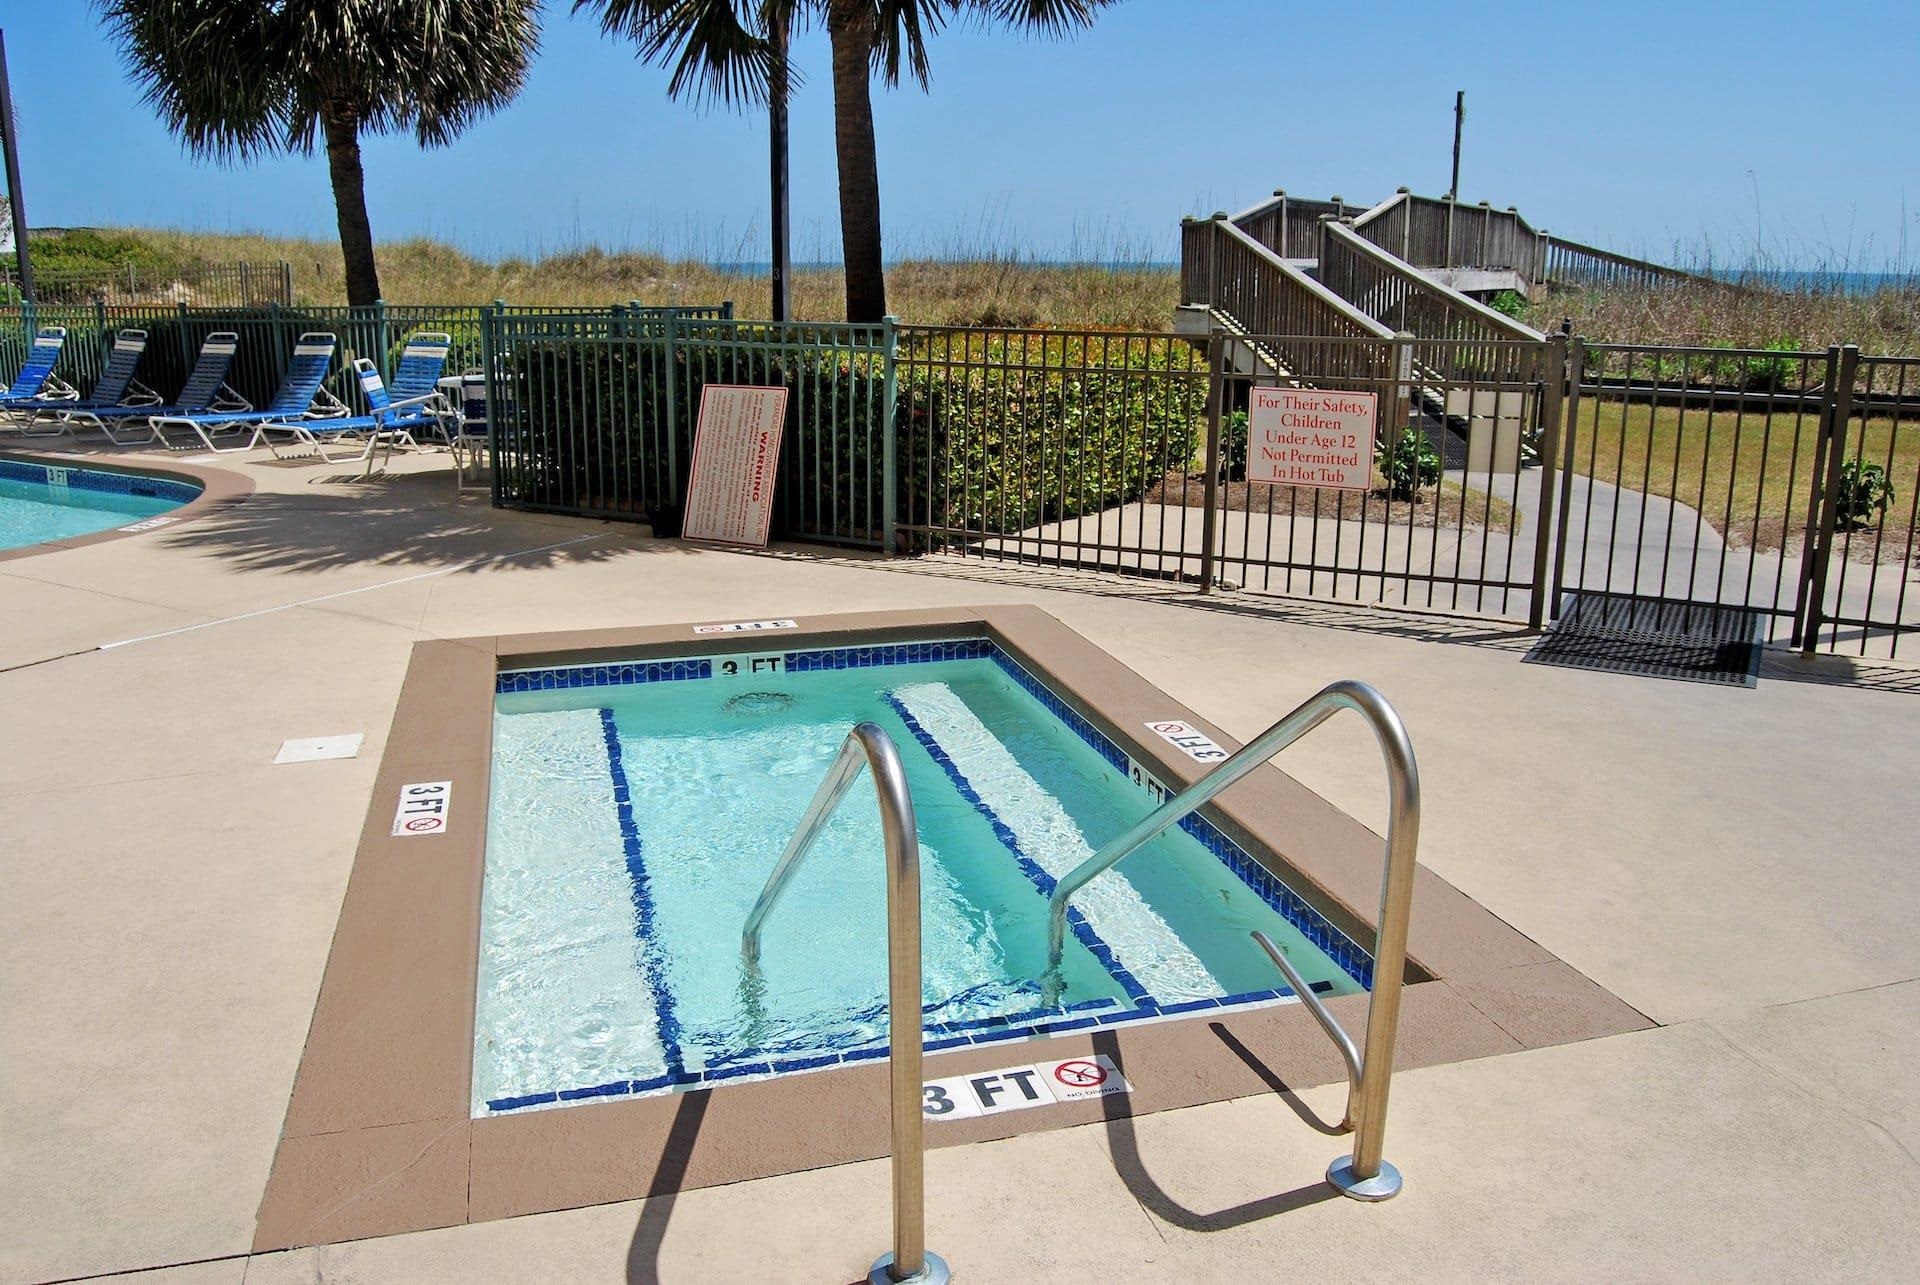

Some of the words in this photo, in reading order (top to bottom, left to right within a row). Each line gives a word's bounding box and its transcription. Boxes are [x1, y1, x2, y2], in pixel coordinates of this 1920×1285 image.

[770, 393, 782, 429] VERANDAS
[1258, 395, 1280, 408] For
[1283, 396, 1320, 411] Their
[1322, 398, 1367, 416] Safety,
[1281, 413, 1341, 430] Children
[1266, 430, 1307, 445] Under
[1311, 434, 1337, 449] Age
[1342, 435, 1356, 448] 12
[763, 430, 777, 478] HOMEOWNERS
[1262, 447, 1286, 461] Not
[1290, 449, 1357, 466] Permitted
[49, 469, 55, 481] 3
[751, 431, 767, 502] WARNING
[1273, 465, 1285, 478] In
[1290, 466, 1314, 480] Hot
[1318, 468, 1344, 483] Tub
[722, 660, 738, 675] 3
[752, 657, 781, 673] FT
[1169, 735, 1212, 748] FT
[1194, 750, 1226, 758] 3
[408, 786, 444, 795] 3
[1133, 767, 1142, 787] 3
[1147, 777, 1163, 805] FT
[404, 798, 443, 814] FT
[922, 1085, 955, 1115] 3
[969, 1070, 1039, 1108] FT
[1066, 1091, 1083, 1099] NO
[1085, 1086, 1121, 1096] DIVING
